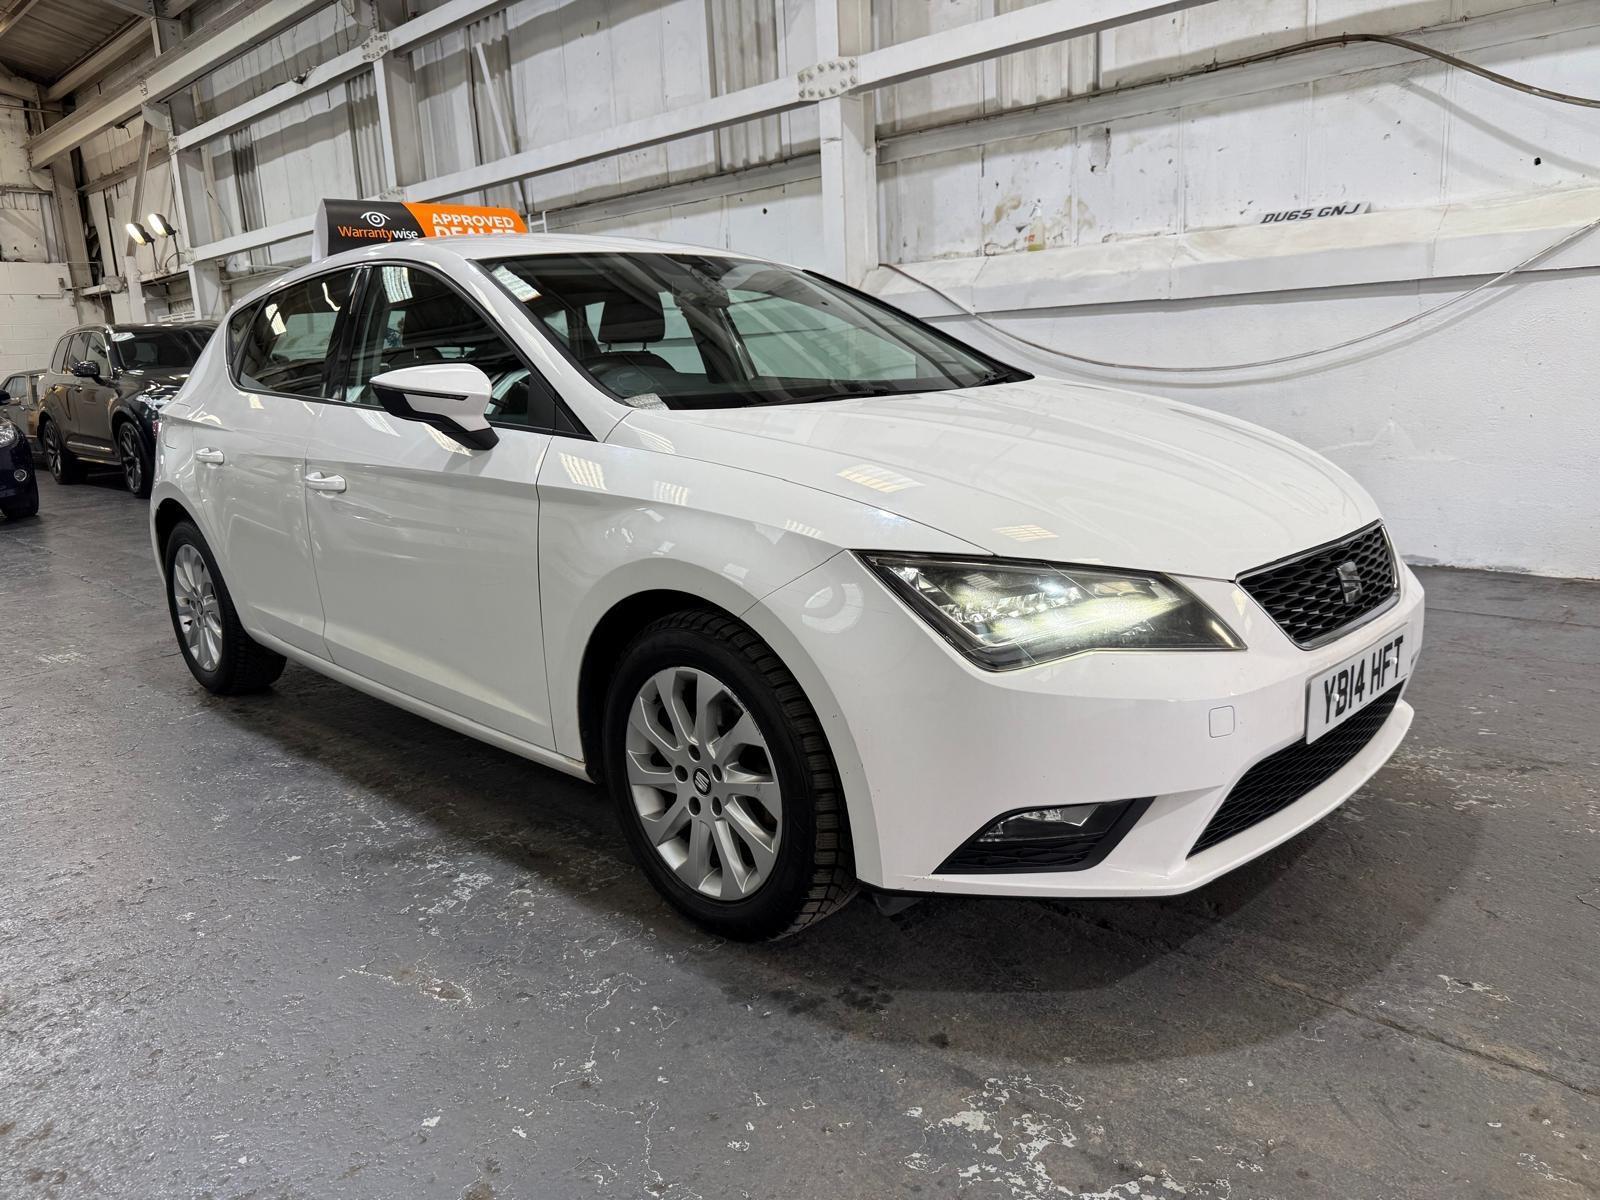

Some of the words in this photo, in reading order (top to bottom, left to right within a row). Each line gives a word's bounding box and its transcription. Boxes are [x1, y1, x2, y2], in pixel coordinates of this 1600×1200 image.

[432, 213, 515, 228] APPROVED
[1260, 208, 1313, 224] DU65
[1317, 203, 1361, 217] GNJ
[337, 225, 419, 242] Warrantywise
[1324, 658, 1366, 725] YB14
[1370, 634, 1404, 696] HFT
